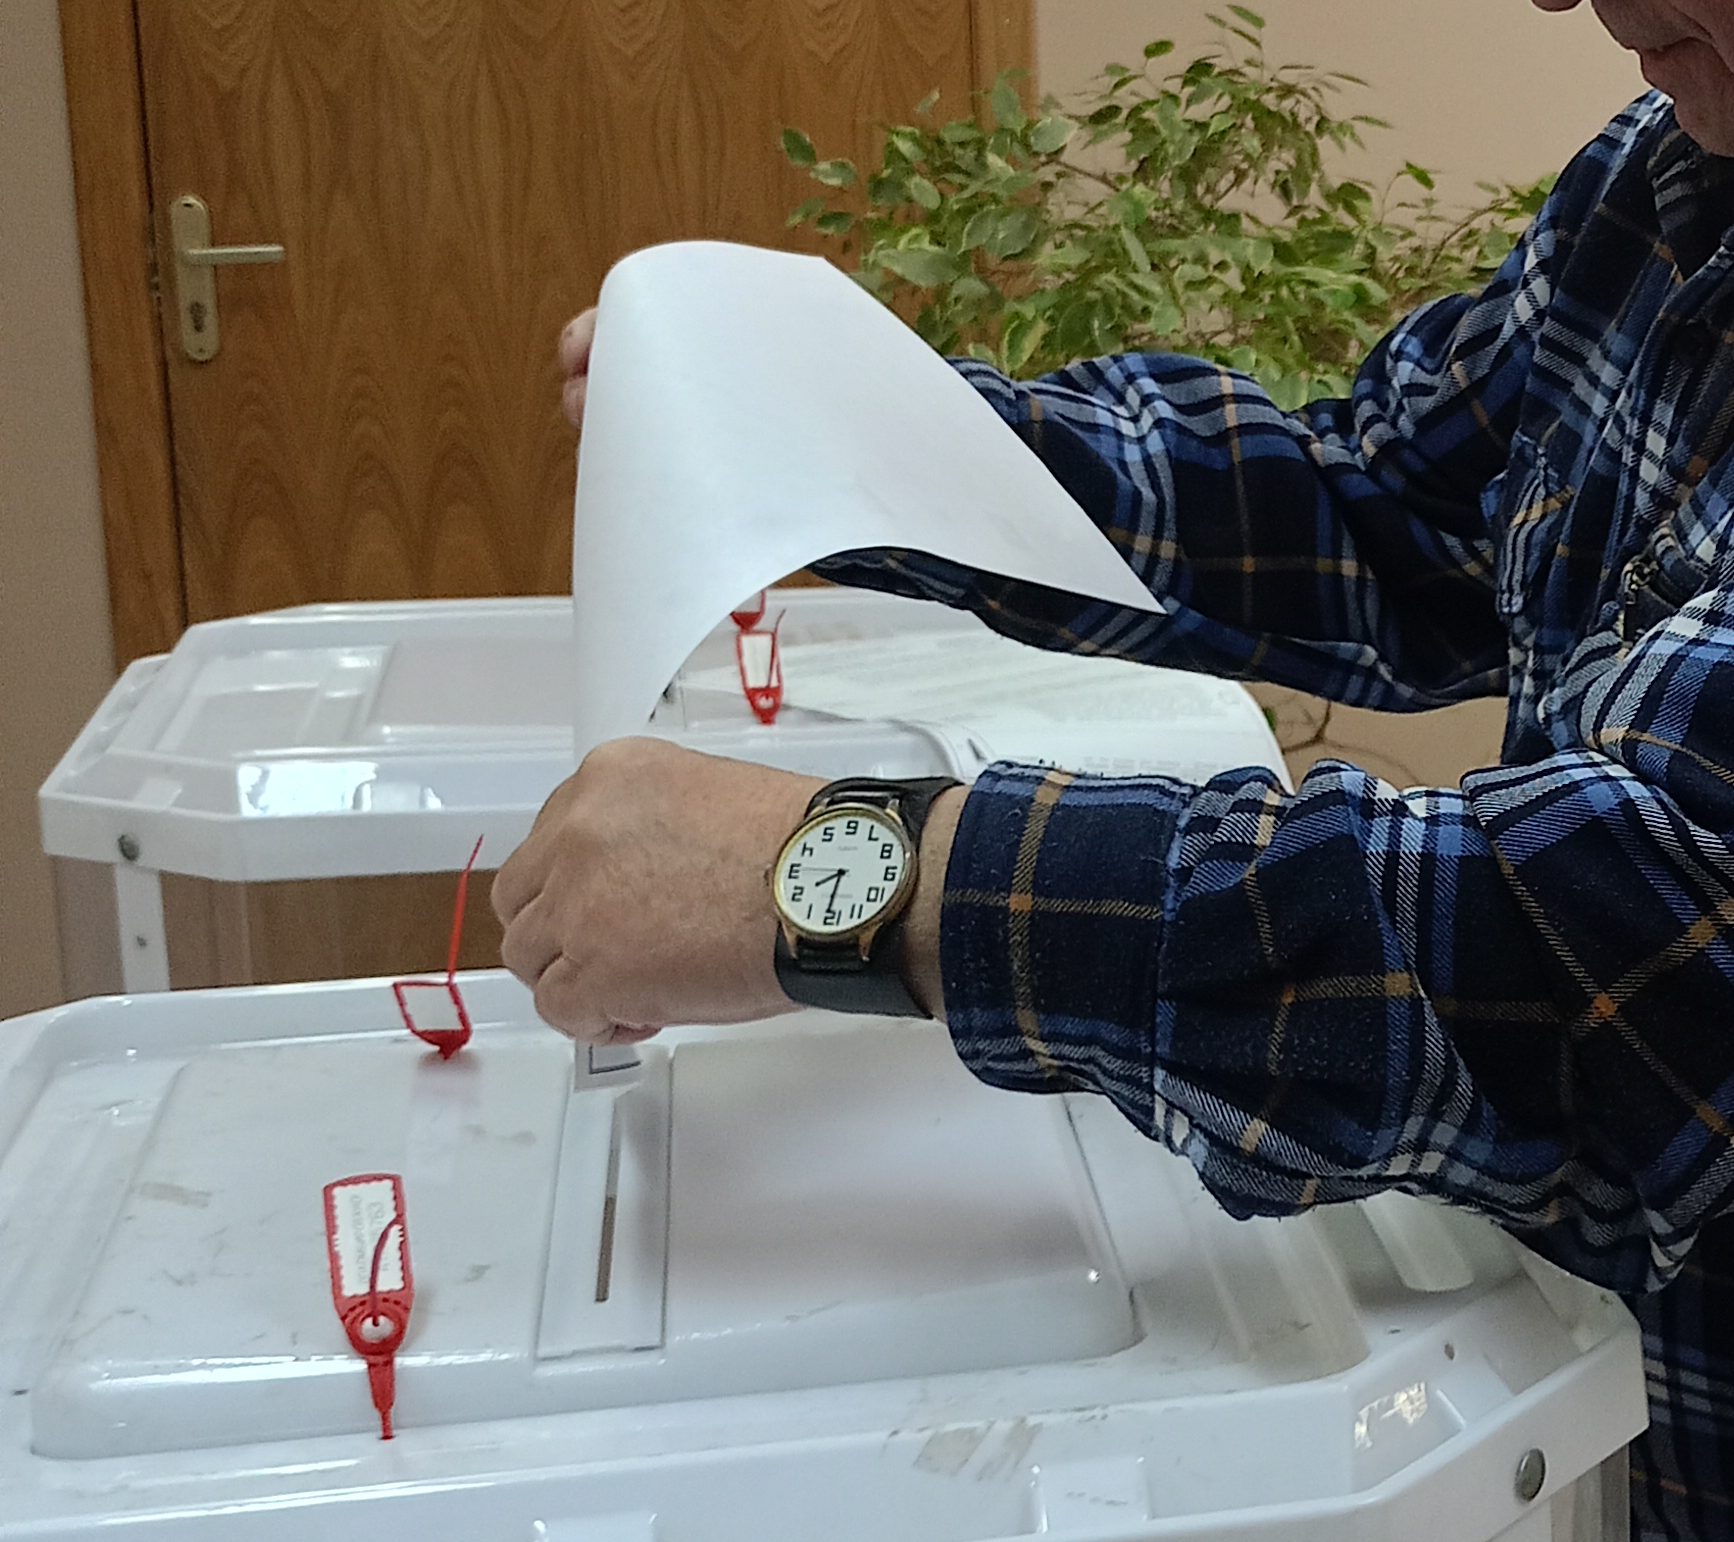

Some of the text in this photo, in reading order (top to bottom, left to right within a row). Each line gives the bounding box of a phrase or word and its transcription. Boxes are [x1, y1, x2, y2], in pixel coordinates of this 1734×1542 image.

[821, 827, 835, 842] 5
[868, 825, 879, 841] 7
[880, 843, 893, 859] 8
[788, 863, 801, 879] 3
[791, 886, 804, 902] 2
[866, 887, 885, 903] 10
[823, 910, 842, 926] 12
[849, 904, 863, 919] 11
